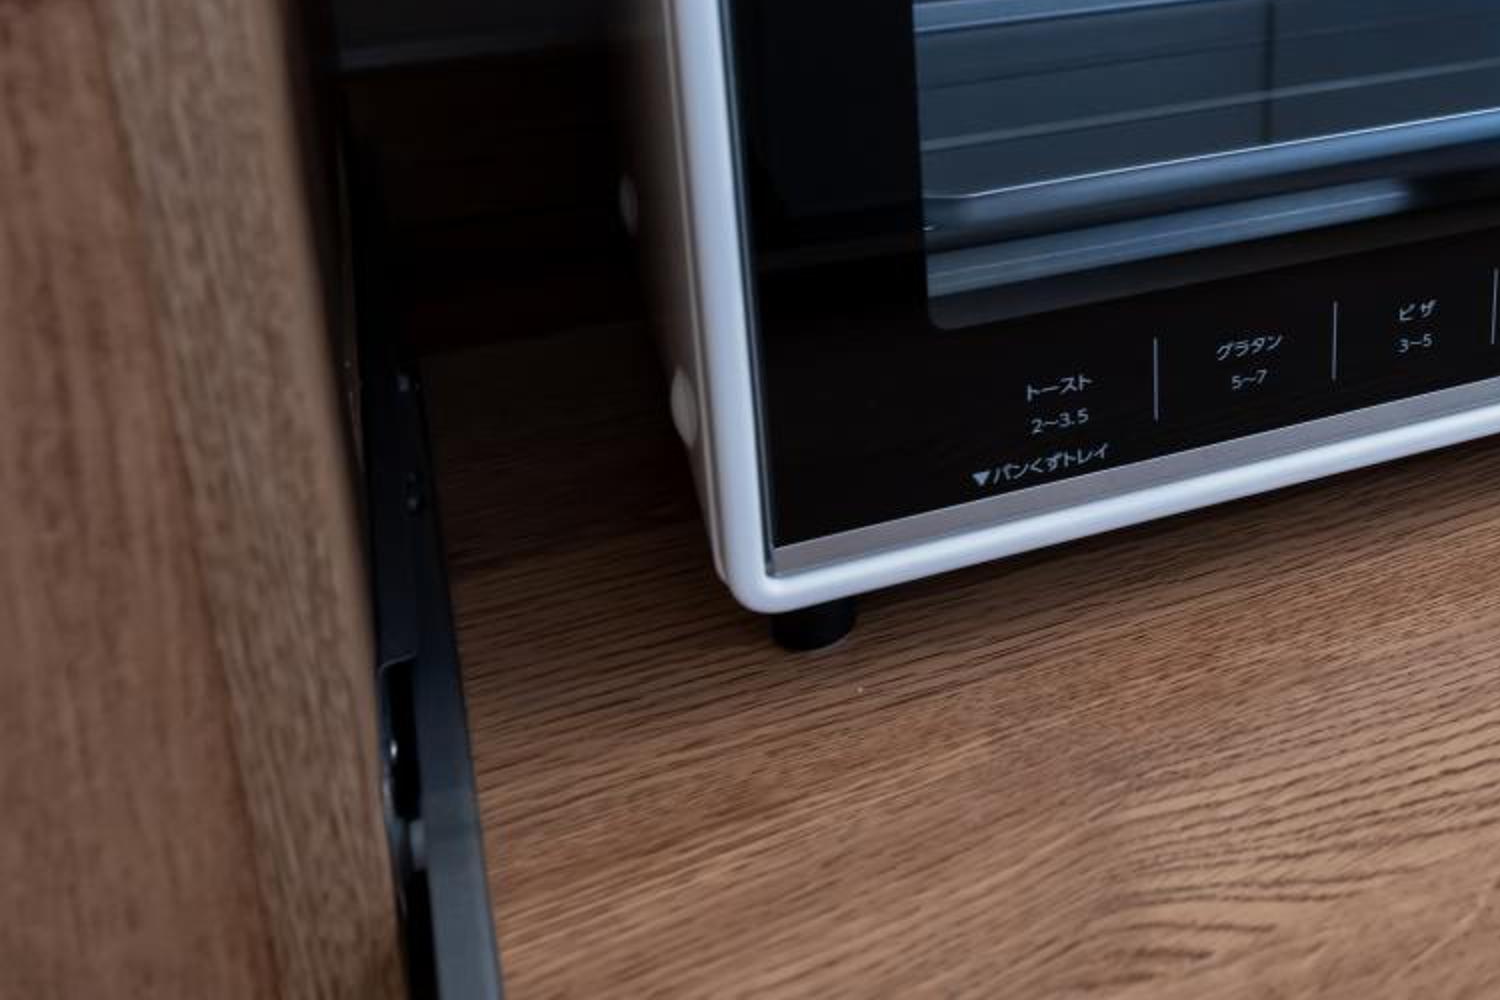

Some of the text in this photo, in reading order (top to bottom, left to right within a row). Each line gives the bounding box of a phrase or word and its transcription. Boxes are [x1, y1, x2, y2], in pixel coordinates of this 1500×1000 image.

[1399, 299, 1437, 321] ピザ
[1216, 334, 1282, 361] グラタン
[1026, 375, 1092, 401] トースト
